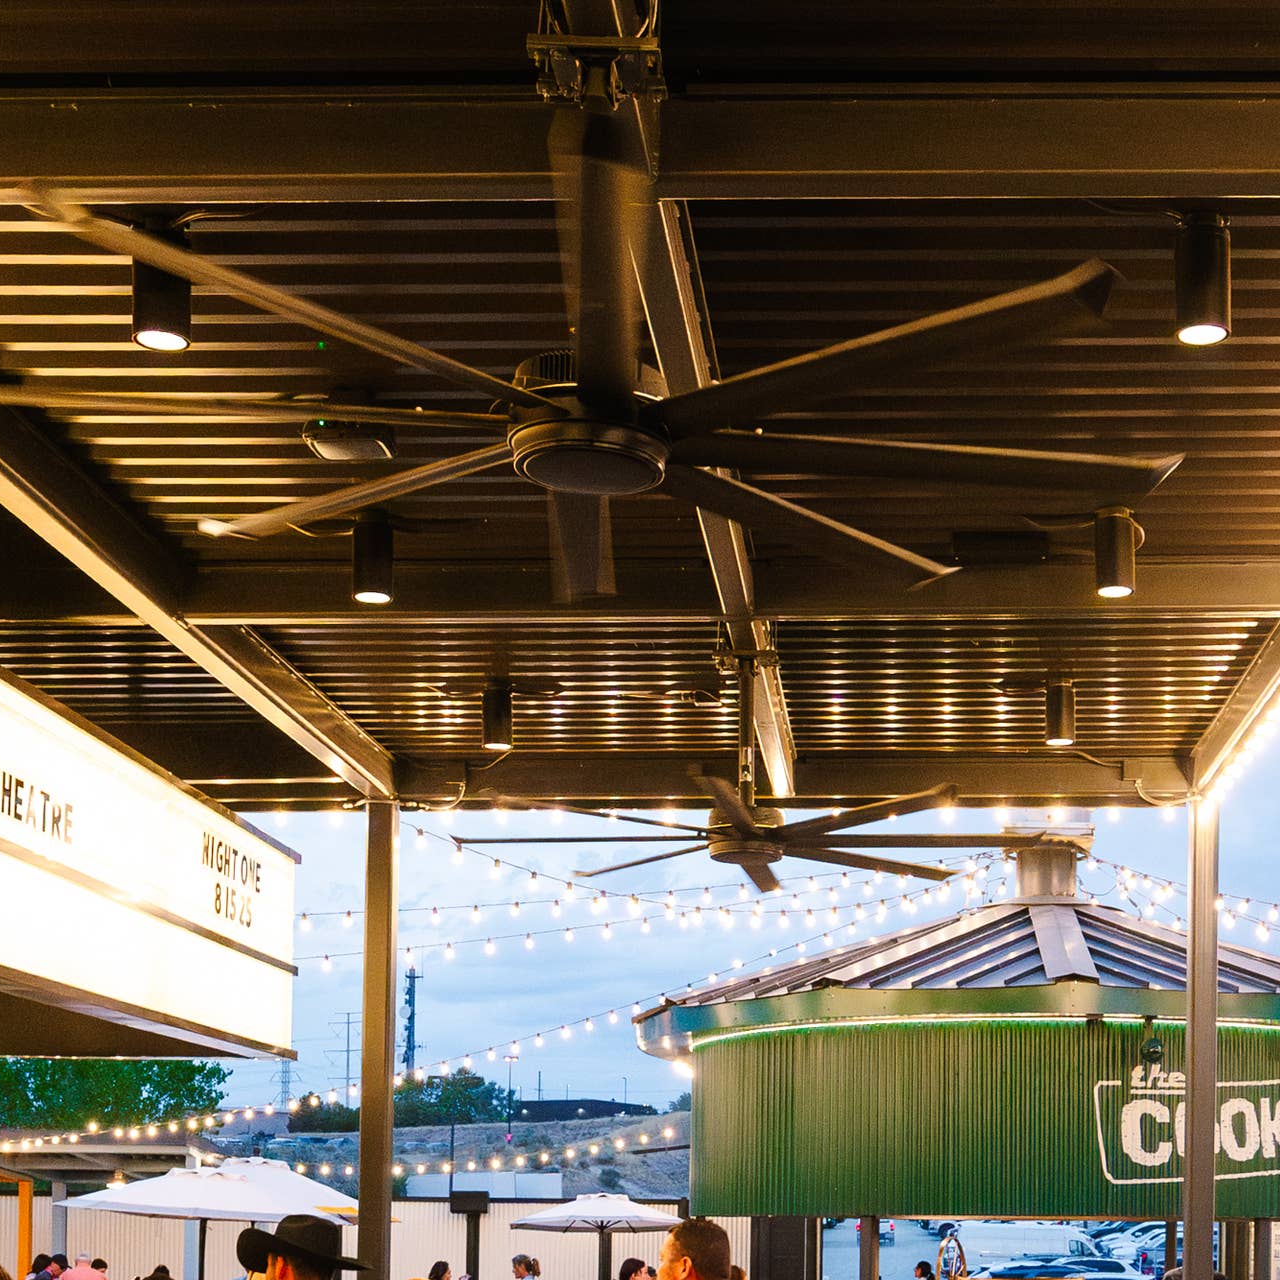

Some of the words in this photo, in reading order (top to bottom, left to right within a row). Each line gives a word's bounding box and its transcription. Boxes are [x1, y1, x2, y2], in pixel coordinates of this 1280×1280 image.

[201, 831, 239, 880] NIGHT
[240, 855, 262, 893] ONE
[214, 882, 222, 915] 8
[1131, 1064, 1186, 1088] the
